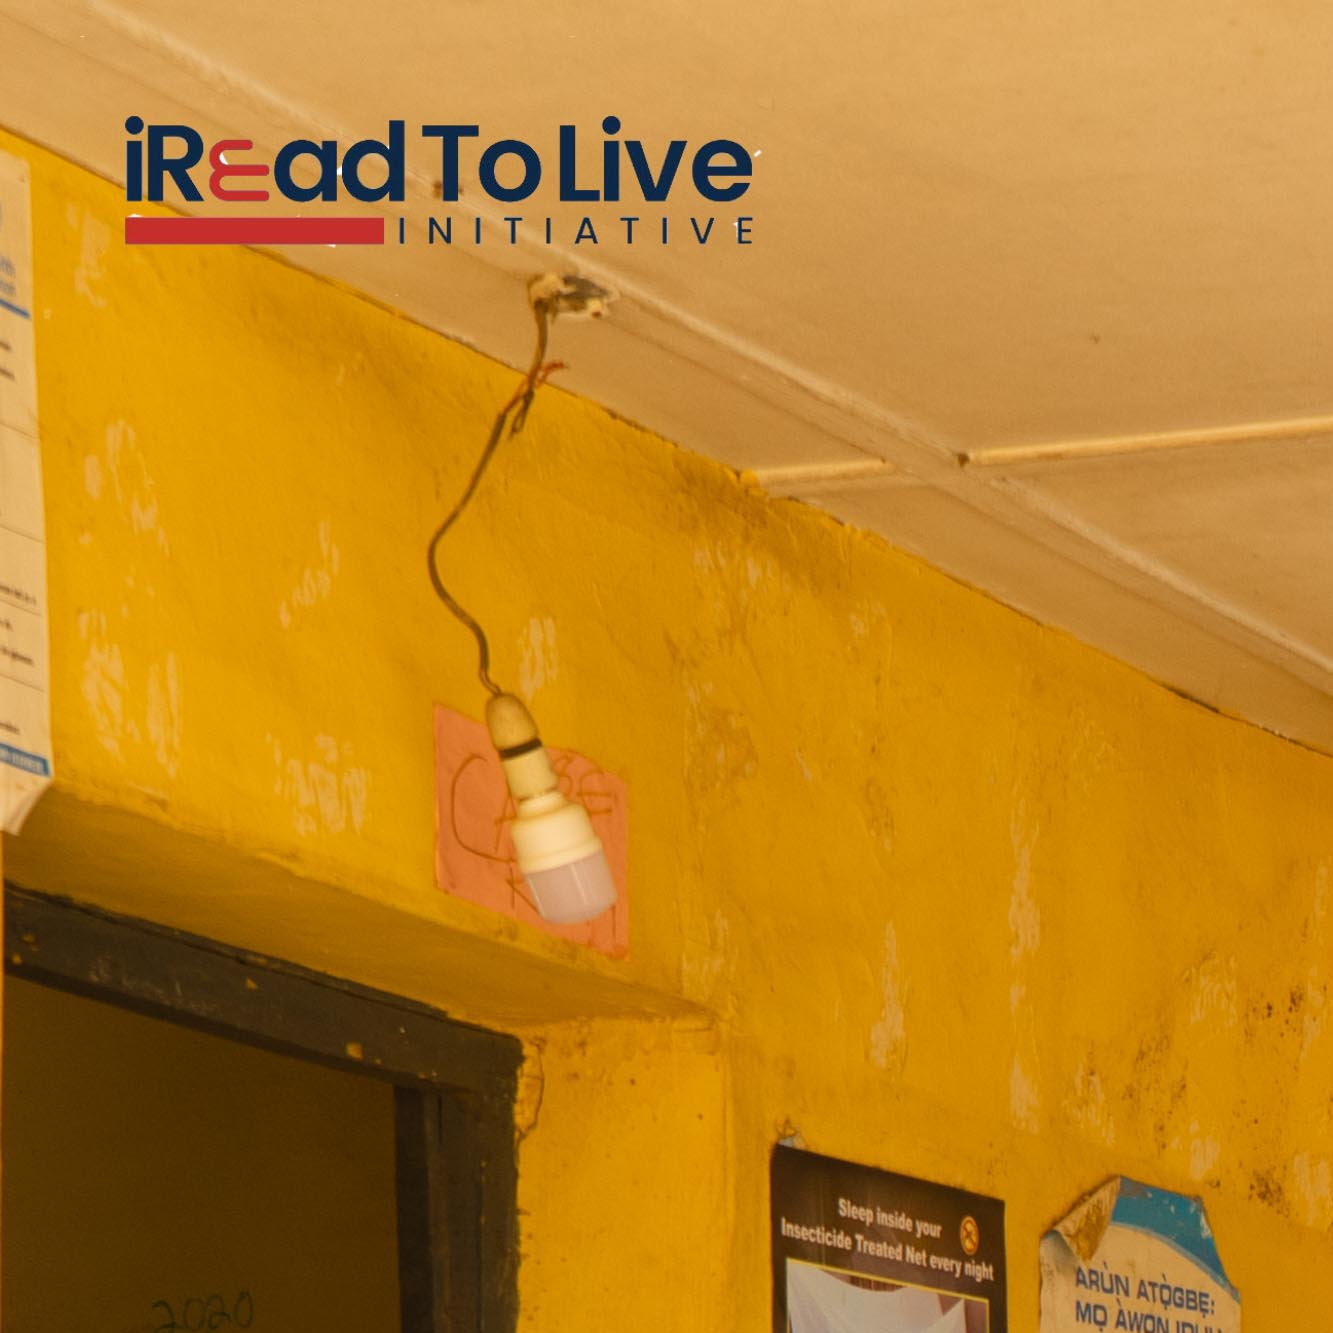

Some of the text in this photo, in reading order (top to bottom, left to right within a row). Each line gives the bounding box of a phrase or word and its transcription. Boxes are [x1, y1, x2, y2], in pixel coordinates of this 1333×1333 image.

[838, 1198, 943, 1239] Sleep inside your
[781, 1217, 994, 1282] Insecticide Treated Net every night
